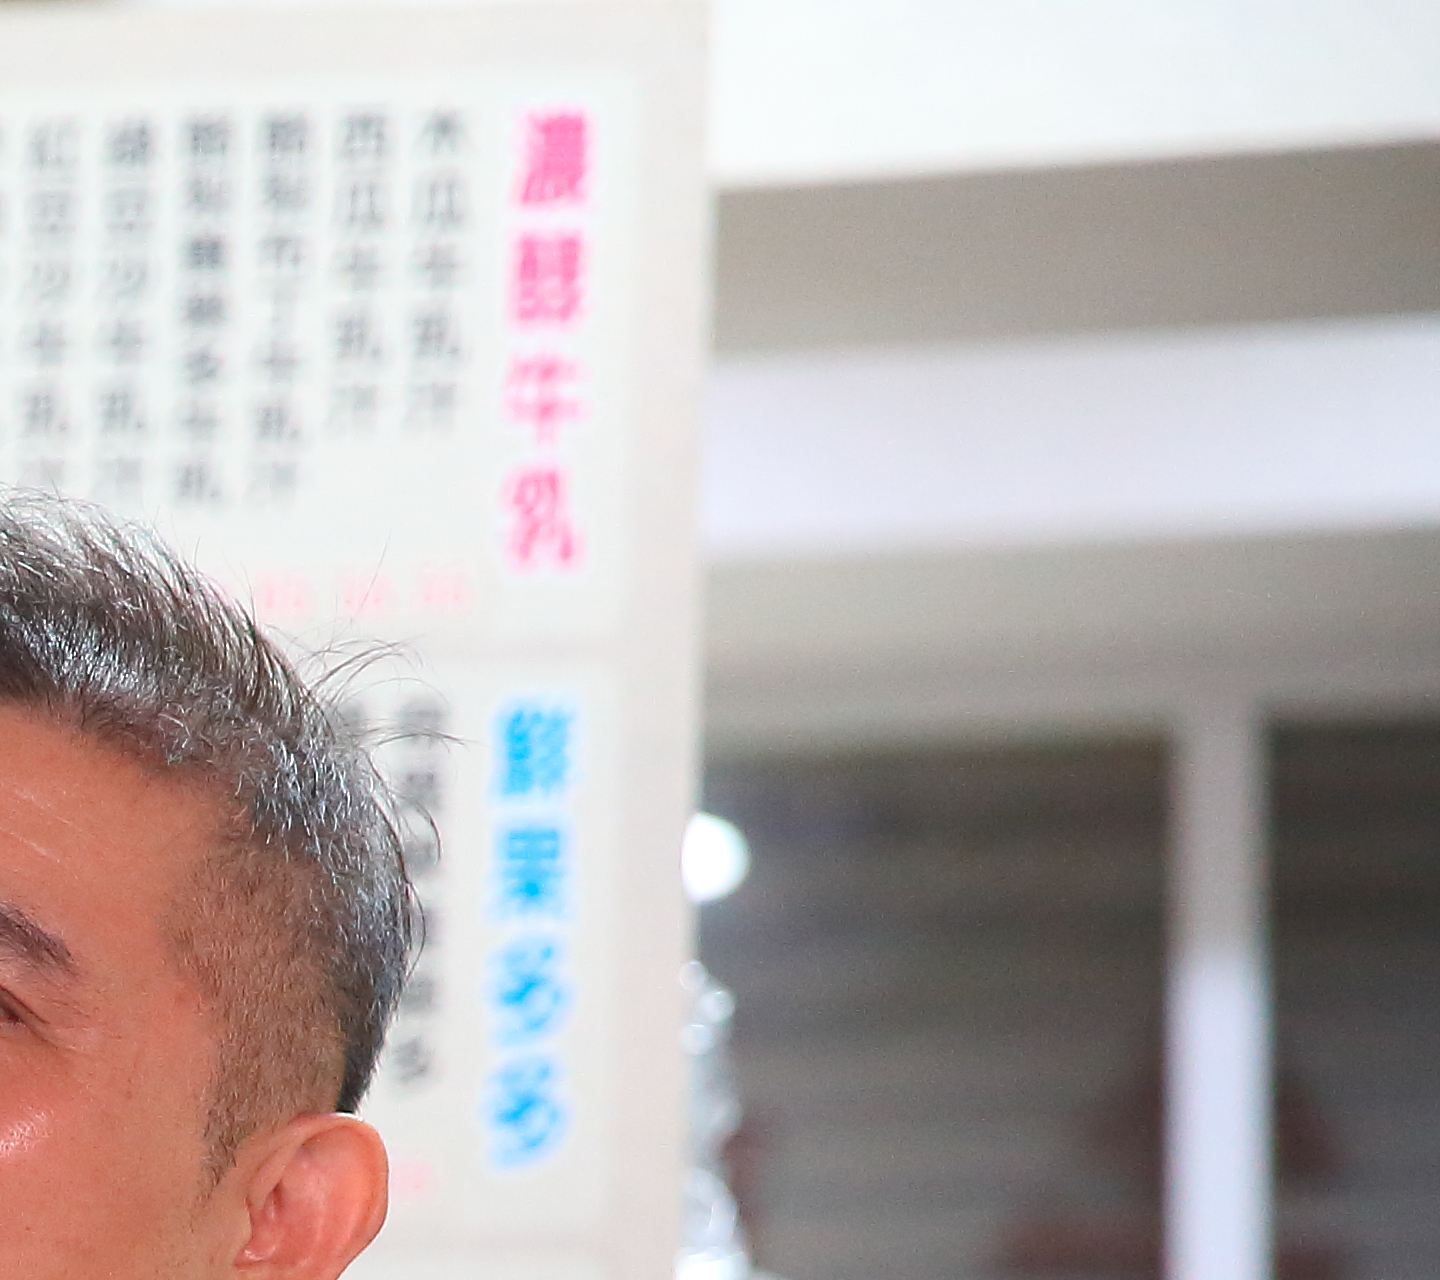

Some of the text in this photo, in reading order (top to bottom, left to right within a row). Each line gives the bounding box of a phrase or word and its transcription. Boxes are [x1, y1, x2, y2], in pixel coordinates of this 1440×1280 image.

[498, 106, 594, 574] 濃醇牛乳
[484, 694, 576, 1168] 鮮果多多
